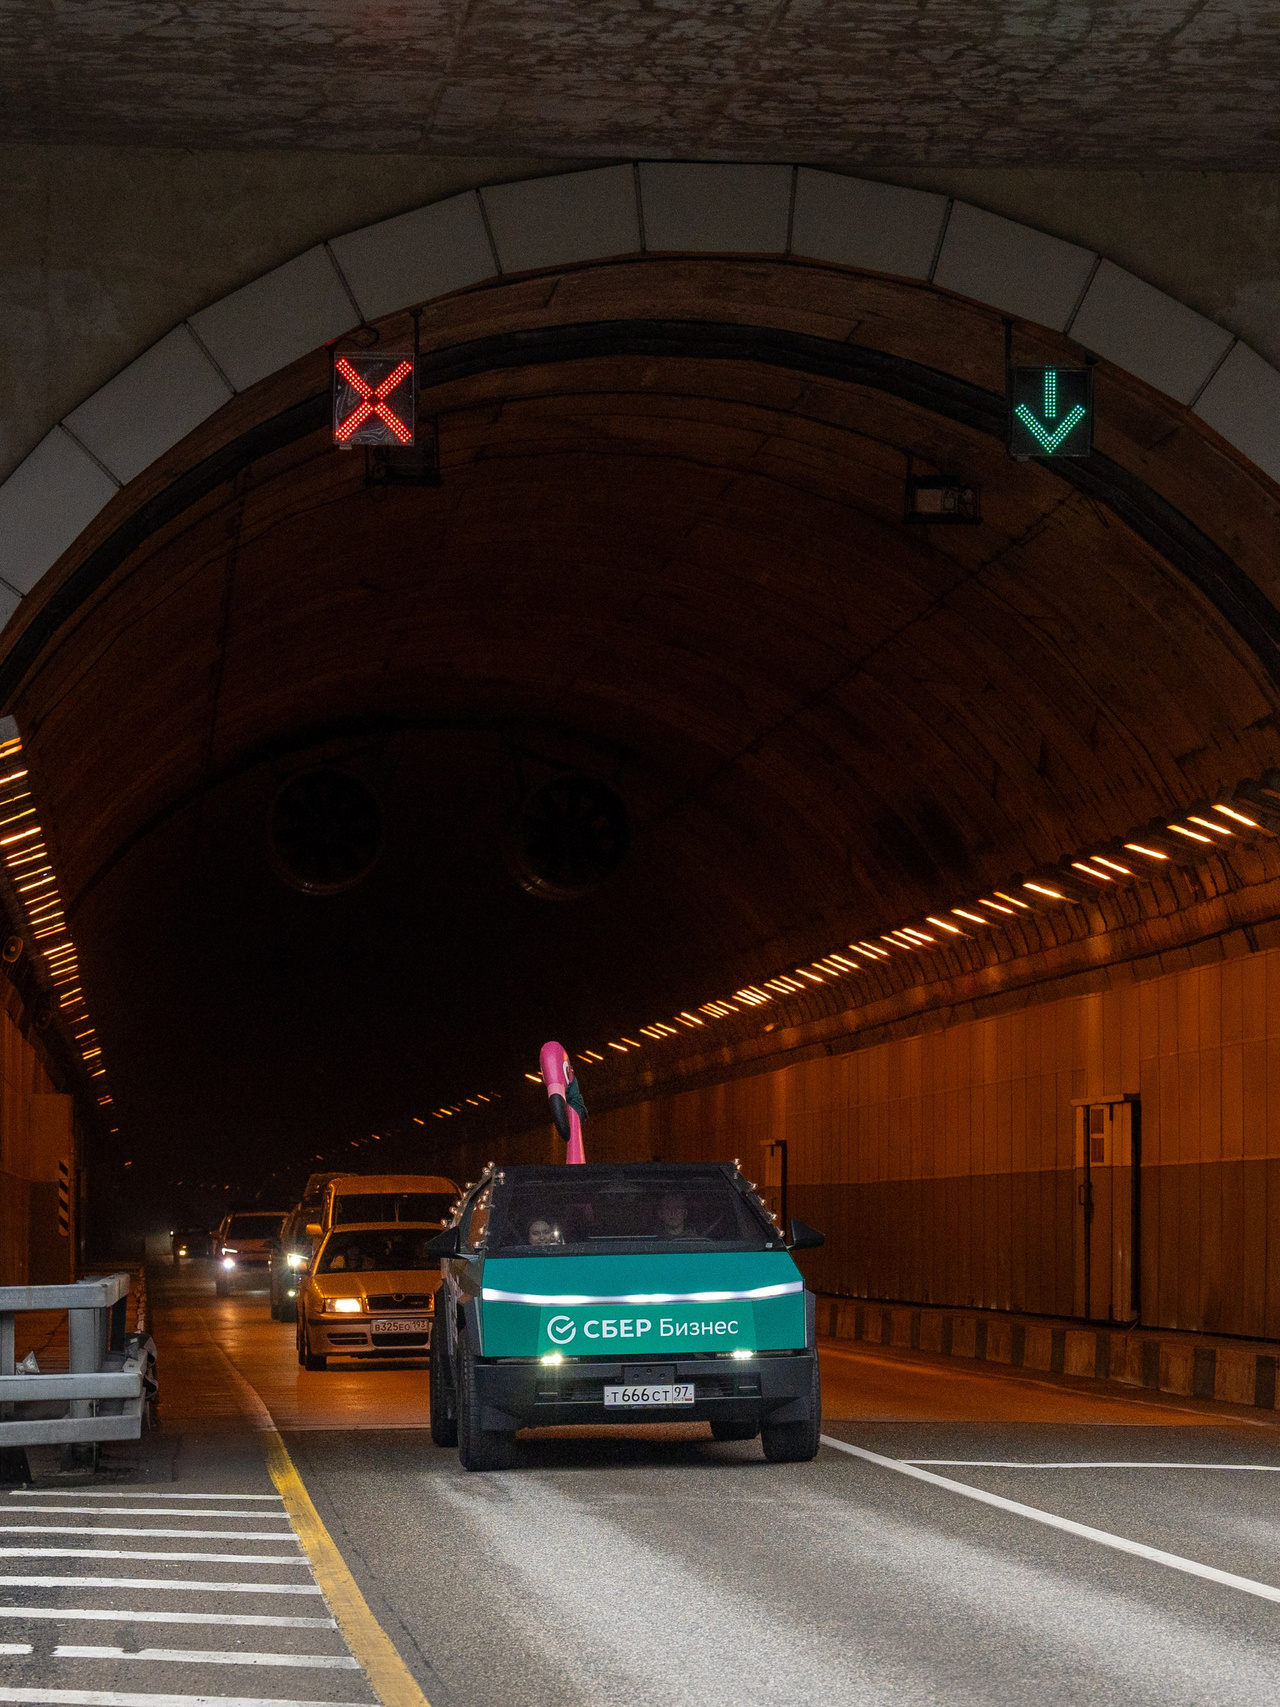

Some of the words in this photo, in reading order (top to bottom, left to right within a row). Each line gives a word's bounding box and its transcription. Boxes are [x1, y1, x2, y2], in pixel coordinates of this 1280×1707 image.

[583, 1318, 652, 1339] СБЕР
[659, 1317, 739, 1337] Бизнес
[674, 1386, 689, 1397] 97
